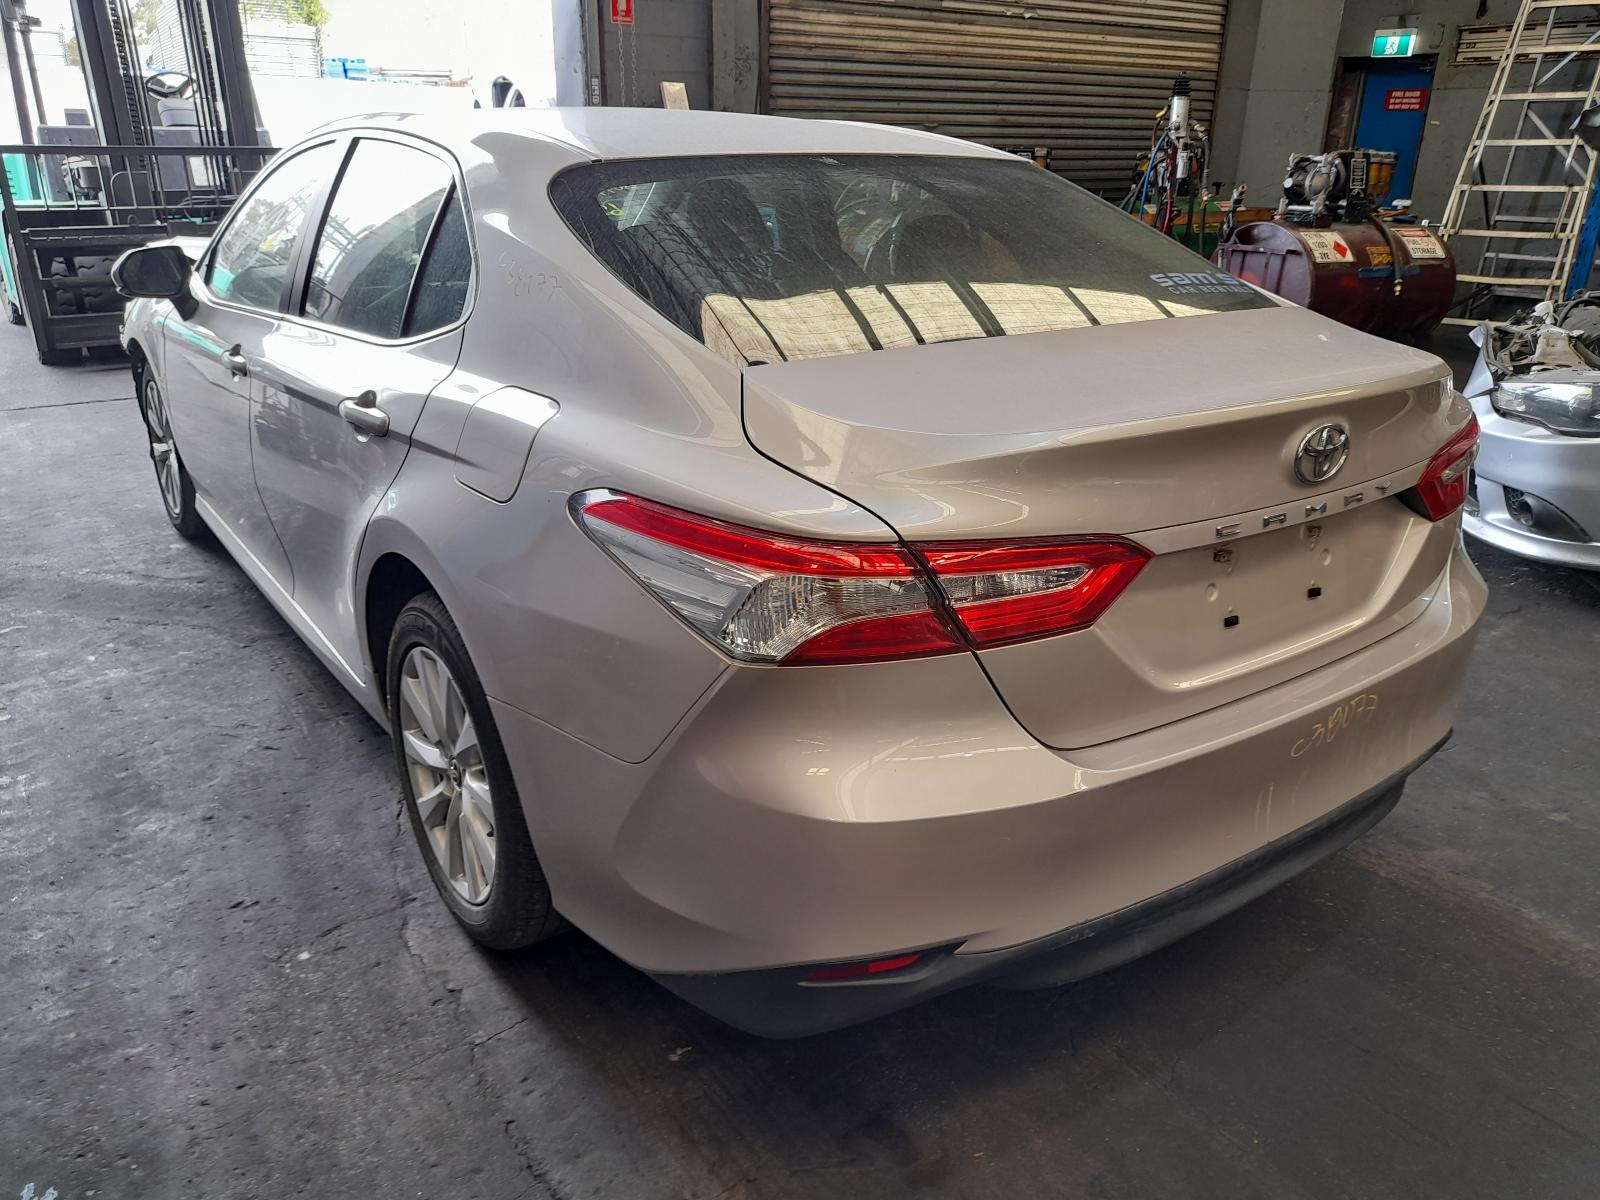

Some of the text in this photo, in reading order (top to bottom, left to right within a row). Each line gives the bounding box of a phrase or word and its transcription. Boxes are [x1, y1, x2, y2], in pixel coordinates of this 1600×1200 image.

[1411, 247, 1438, 255] STORAGE
[1168, 286, 1199, 295] CAR
[1215, 480, 1392, 538] CAMRY
